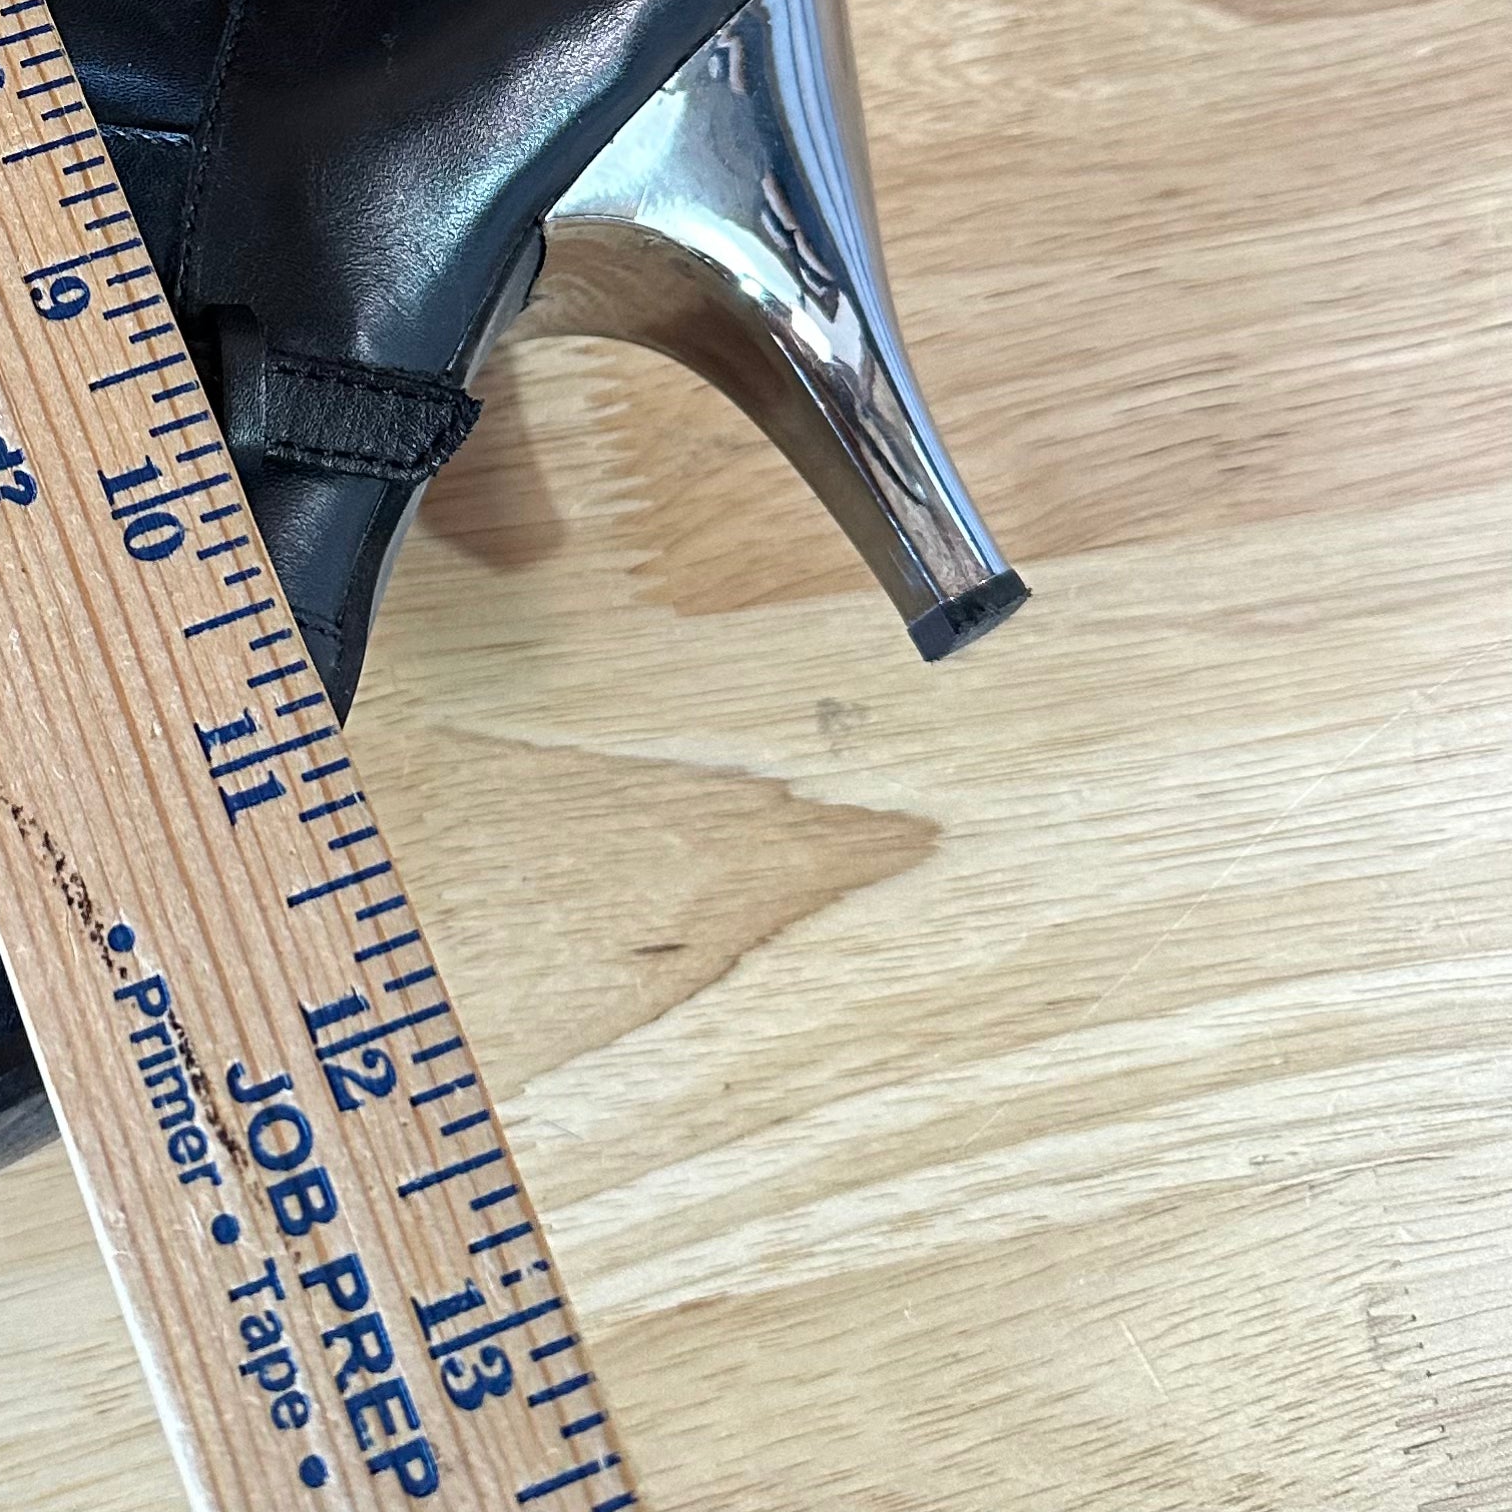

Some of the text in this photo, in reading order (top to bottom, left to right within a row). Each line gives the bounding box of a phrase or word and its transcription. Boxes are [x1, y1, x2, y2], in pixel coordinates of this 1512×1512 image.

[29, 274, 91, 321] 9
[97, 455, 186, 562] 10
[193, 706, 287, 827] 11
[298, 984, 397, 1112] 12
[113, 973, 311, 1431] Primer Tape
[225, 1059, 440, 1498] JOB PREP
[410, 1277, 514, 1412] 13
